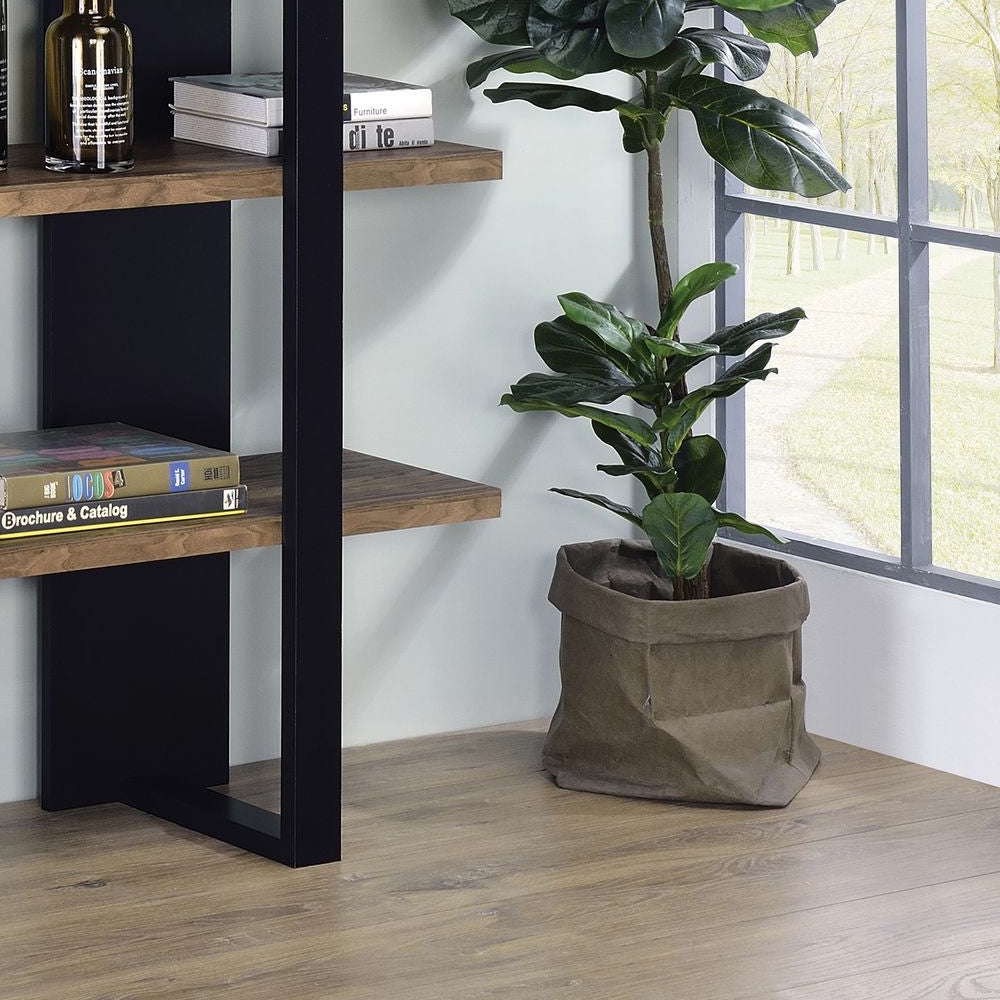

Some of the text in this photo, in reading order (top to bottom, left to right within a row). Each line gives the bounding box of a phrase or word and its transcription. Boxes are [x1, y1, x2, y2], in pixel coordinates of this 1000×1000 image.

[78, 66, 123, 75] Scannavian
[353, 108, 387, 117] Furniture
[348, 125, 394, 149] di te
[1, 503, 128, 529] Brochure & Catalog
